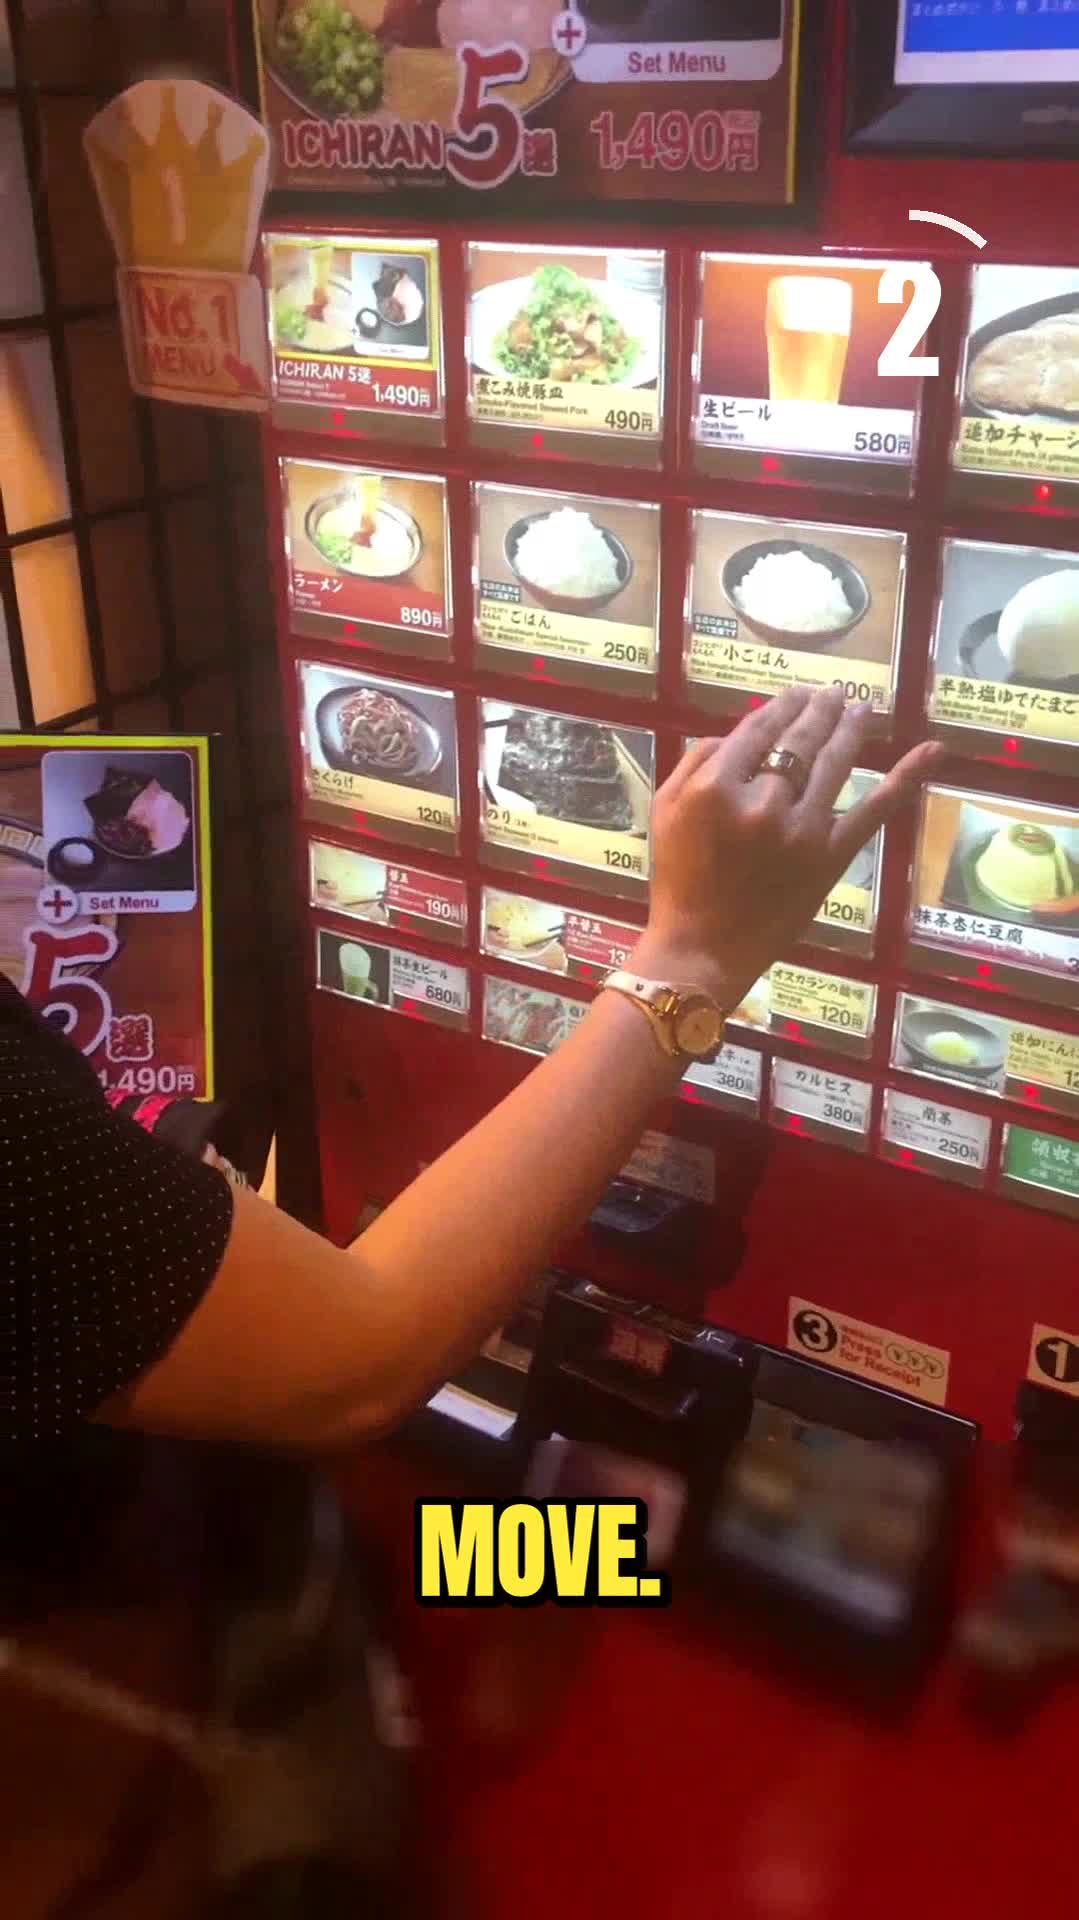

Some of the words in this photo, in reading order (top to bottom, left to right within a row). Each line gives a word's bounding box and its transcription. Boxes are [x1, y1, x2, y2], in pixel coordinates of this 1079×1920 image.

[627, 50, 662, 76] Set
[667, 49, 726, 74] Menu
[281, 119, 447, 170] ICHIRAN
[146, 345, 217, 377] MENU
[279, 360, 344, 380] ICHIRAN
[604, 409, 653, 432] 490円
[702, 398, 772, 421] 生ビール
[854, 431, 911, 455] 580円
[293, 572, 344, 593] ラーメン
[400, 606, 443, 629] 890円
[511, 609, 551, 630] ごはん
[603, 641, 649, 665] 250円
[724, 644, 789, 670] 小ごはん
[487, 808, 511, 825] のり
[90, 896, 115, 911] Set
[118, 895, 160, 909] Menu
